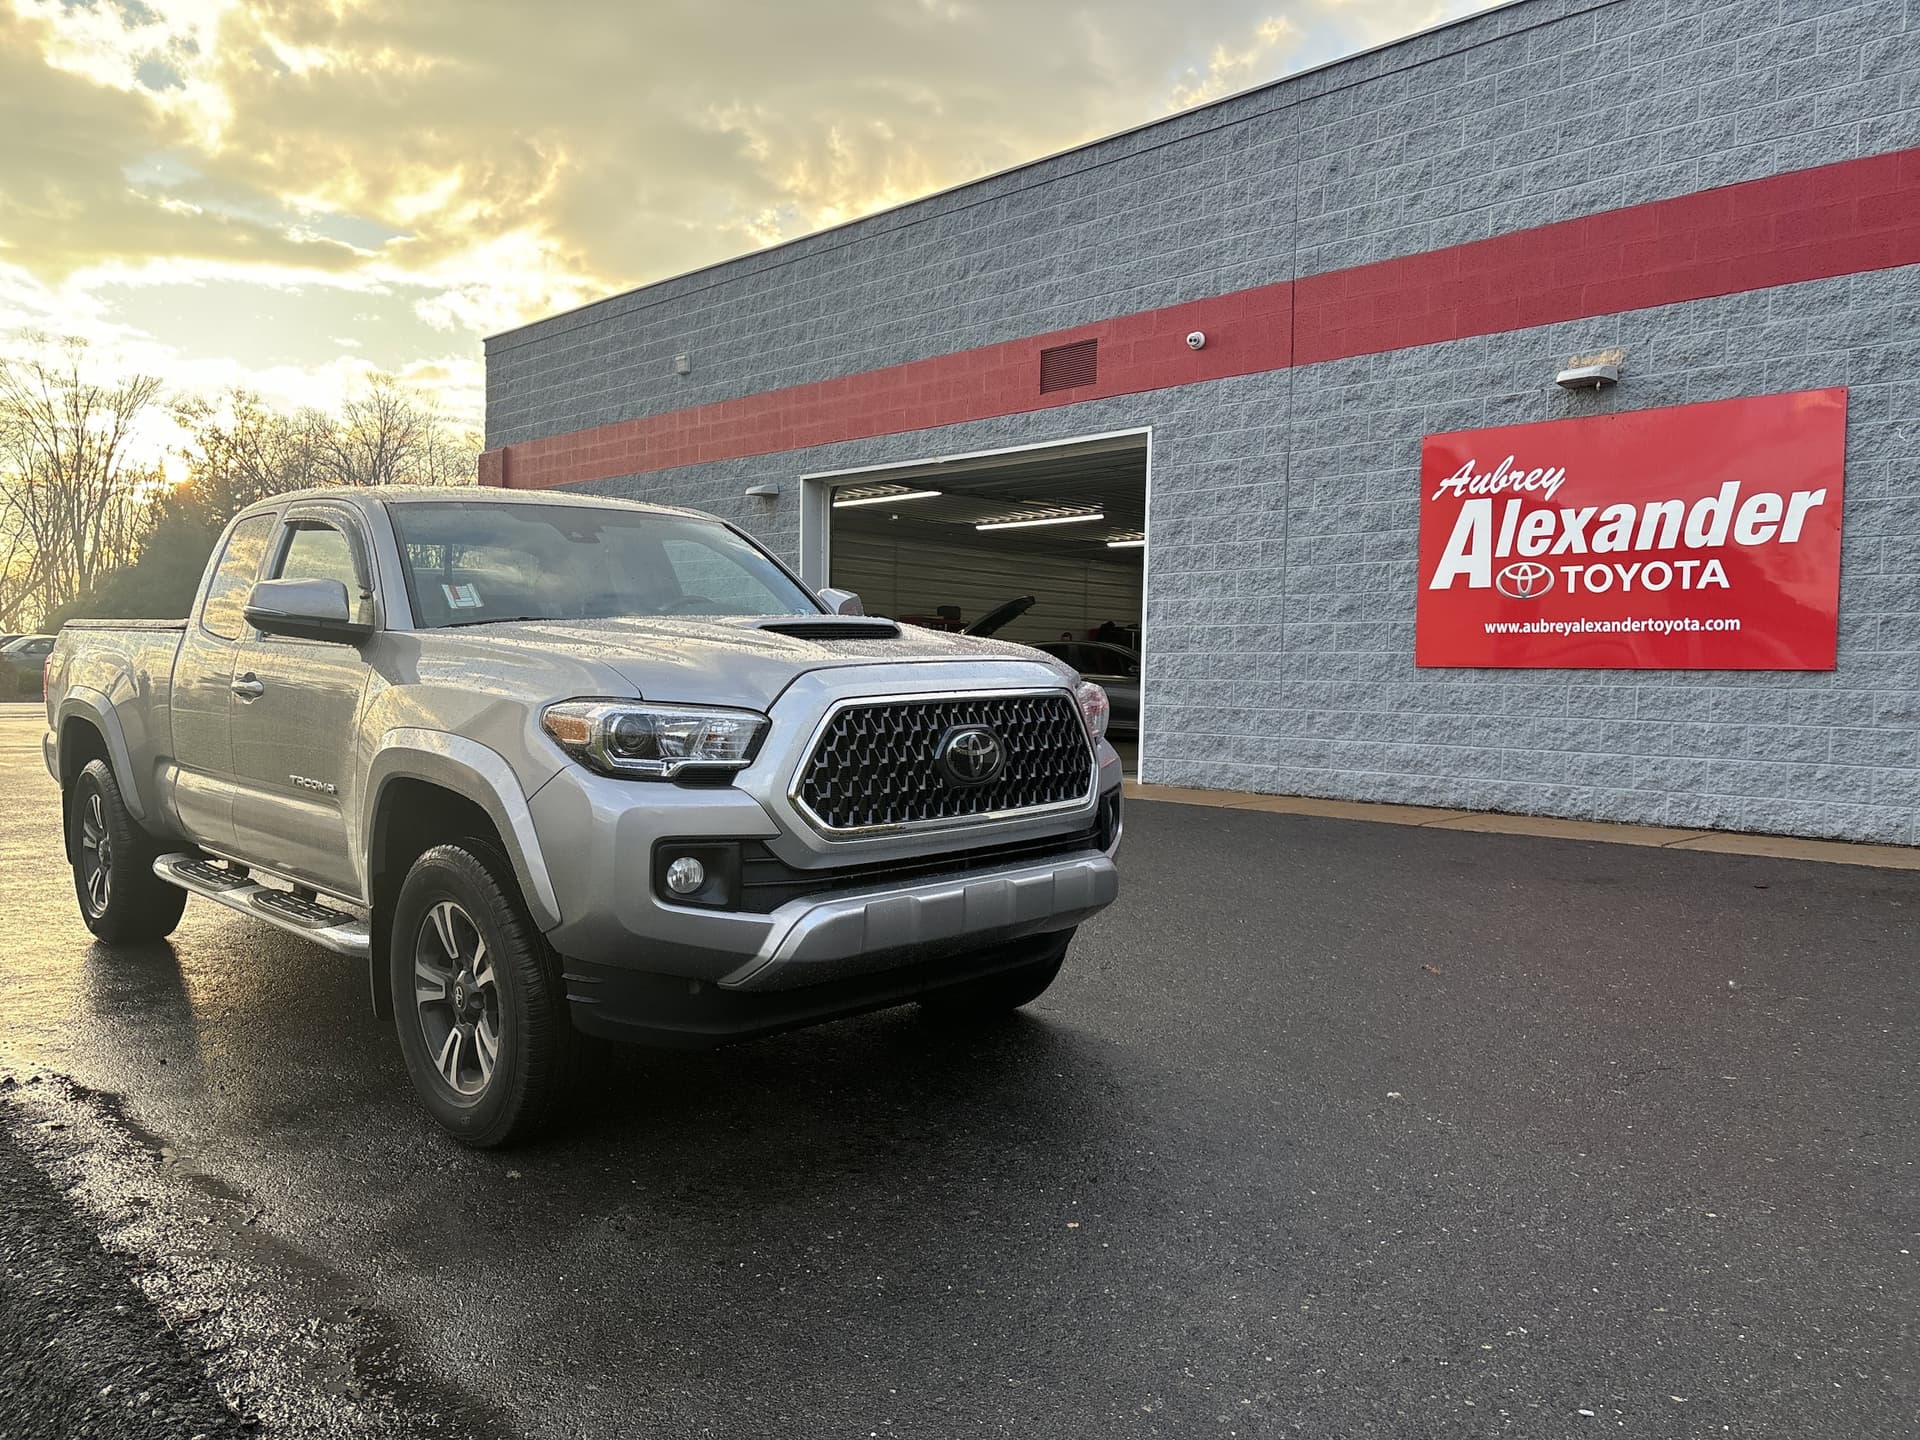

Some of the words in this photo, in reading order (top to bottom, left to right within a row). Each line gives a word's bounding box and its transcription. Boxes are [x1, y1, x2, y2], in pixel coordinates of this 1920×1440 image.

[1432, 455, 1567, 501] Aubrey
[1429, 481, 1827, 589] Alexander
[1560, 559, 1731, 594] TOYOTA
[1484, 617, 1741, 637] www.aubreyalexandertoyota.com
